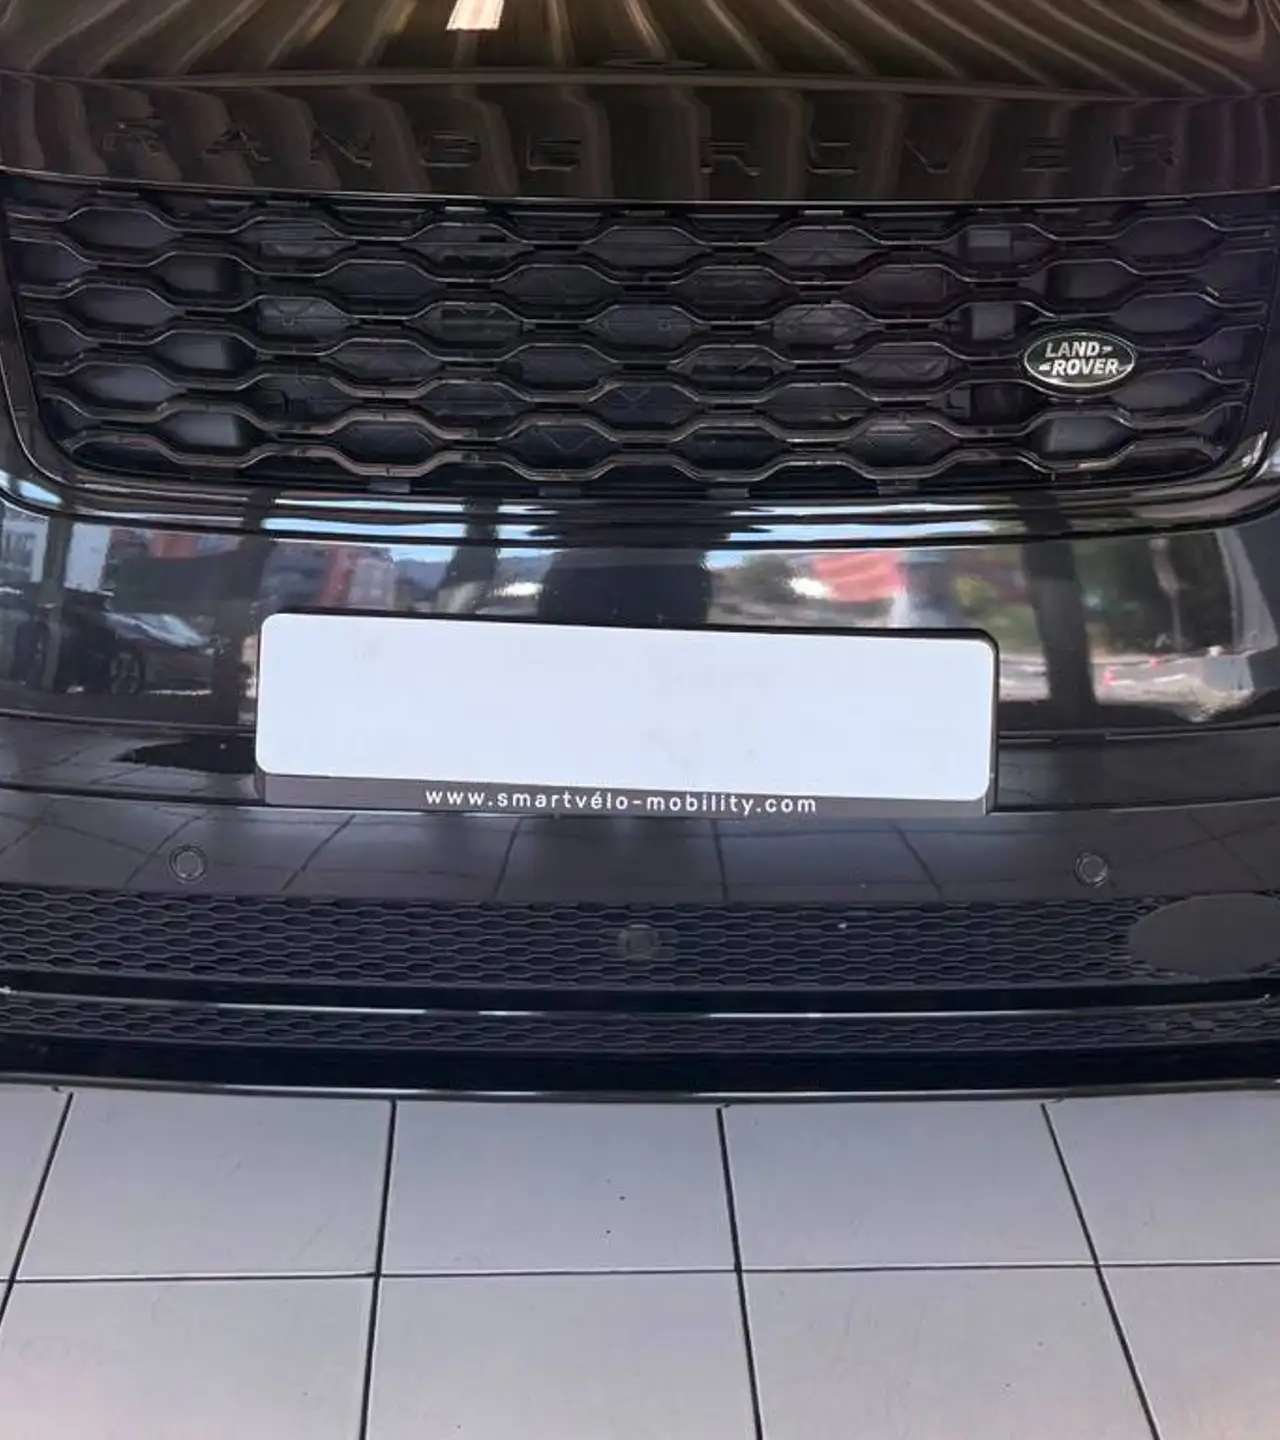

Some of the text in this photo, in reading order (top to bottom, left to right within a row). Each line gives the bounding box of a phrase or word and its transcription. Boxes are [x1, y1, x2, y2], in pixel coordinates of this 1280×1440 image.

[100, 120, 1180, 176] RANGE ROVER
[1046, 342, 1101, 357] LAND
[1052, 359, 1119, 376] ROVER
[425, 789, 818, 815] www.smartvélo-mobility.com
